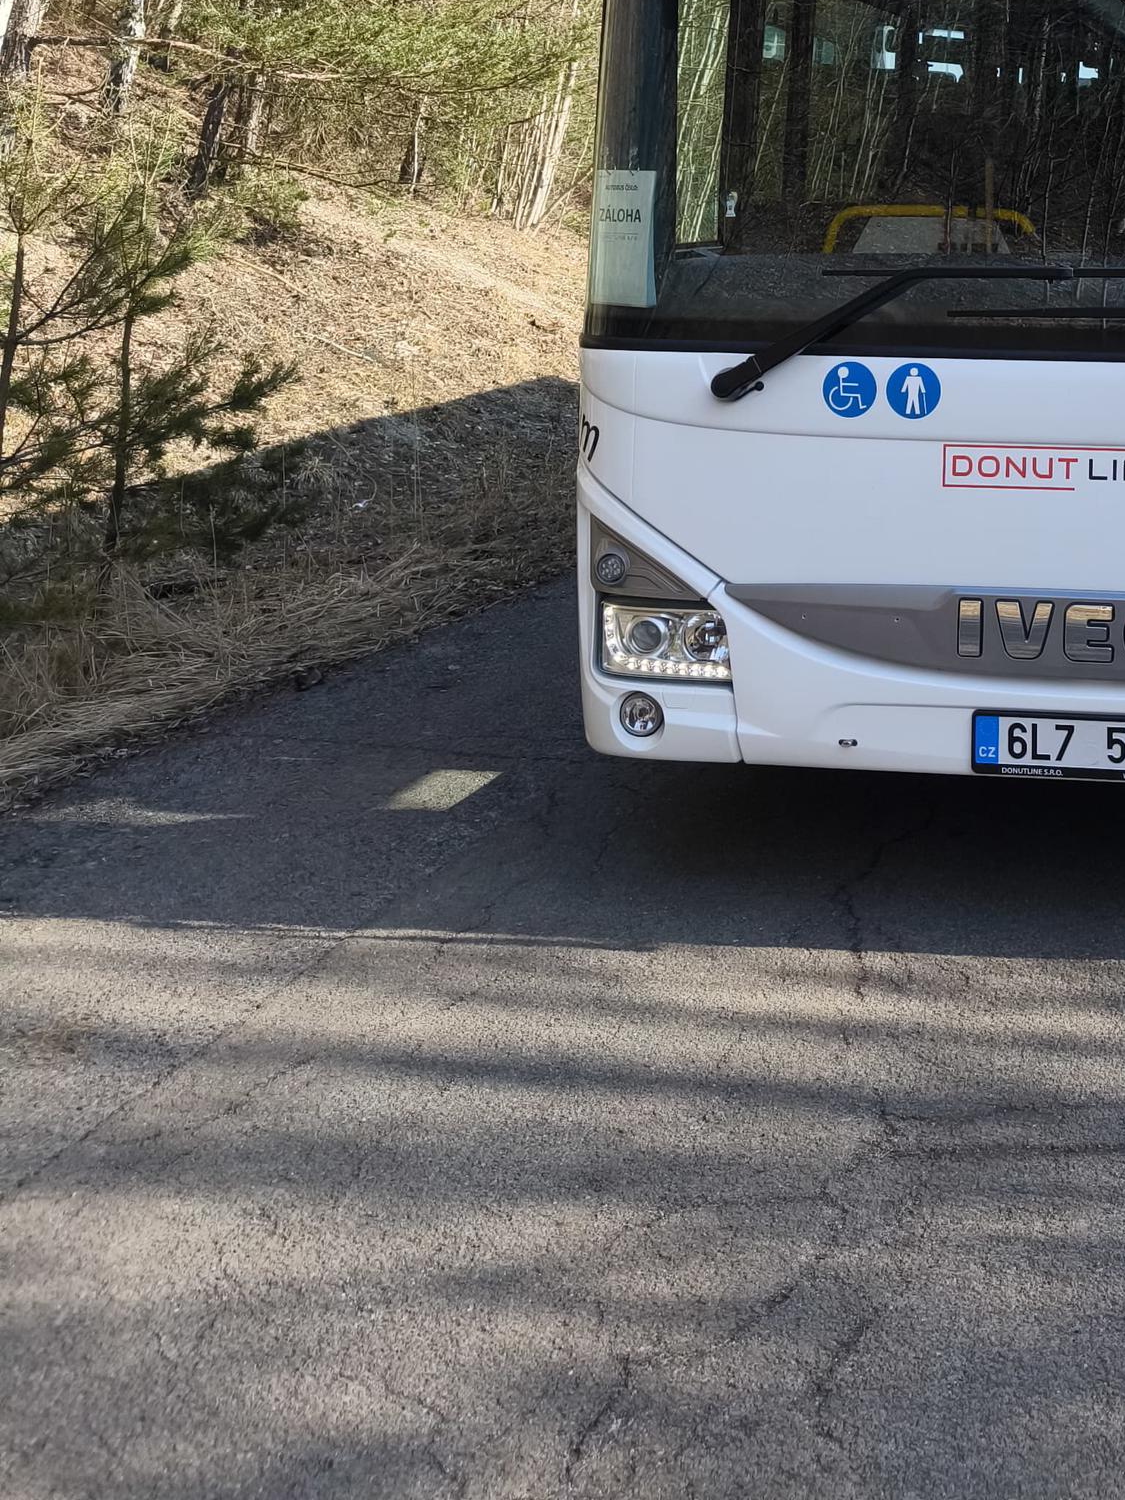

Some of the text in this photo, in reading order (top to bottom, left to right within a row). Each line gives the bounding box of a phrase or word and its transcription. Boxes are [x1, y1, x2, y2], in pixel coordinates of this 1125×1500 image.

[599, 204, 641, 223] ZÁLOHA
[951, 455, 1079, 480] DONUT
[1007, 722, 1075, 761] 6L7
[979, 746, 996, 758] CZ
[1001, 767, 1064, 777] DONUTLINE S.R.O.
